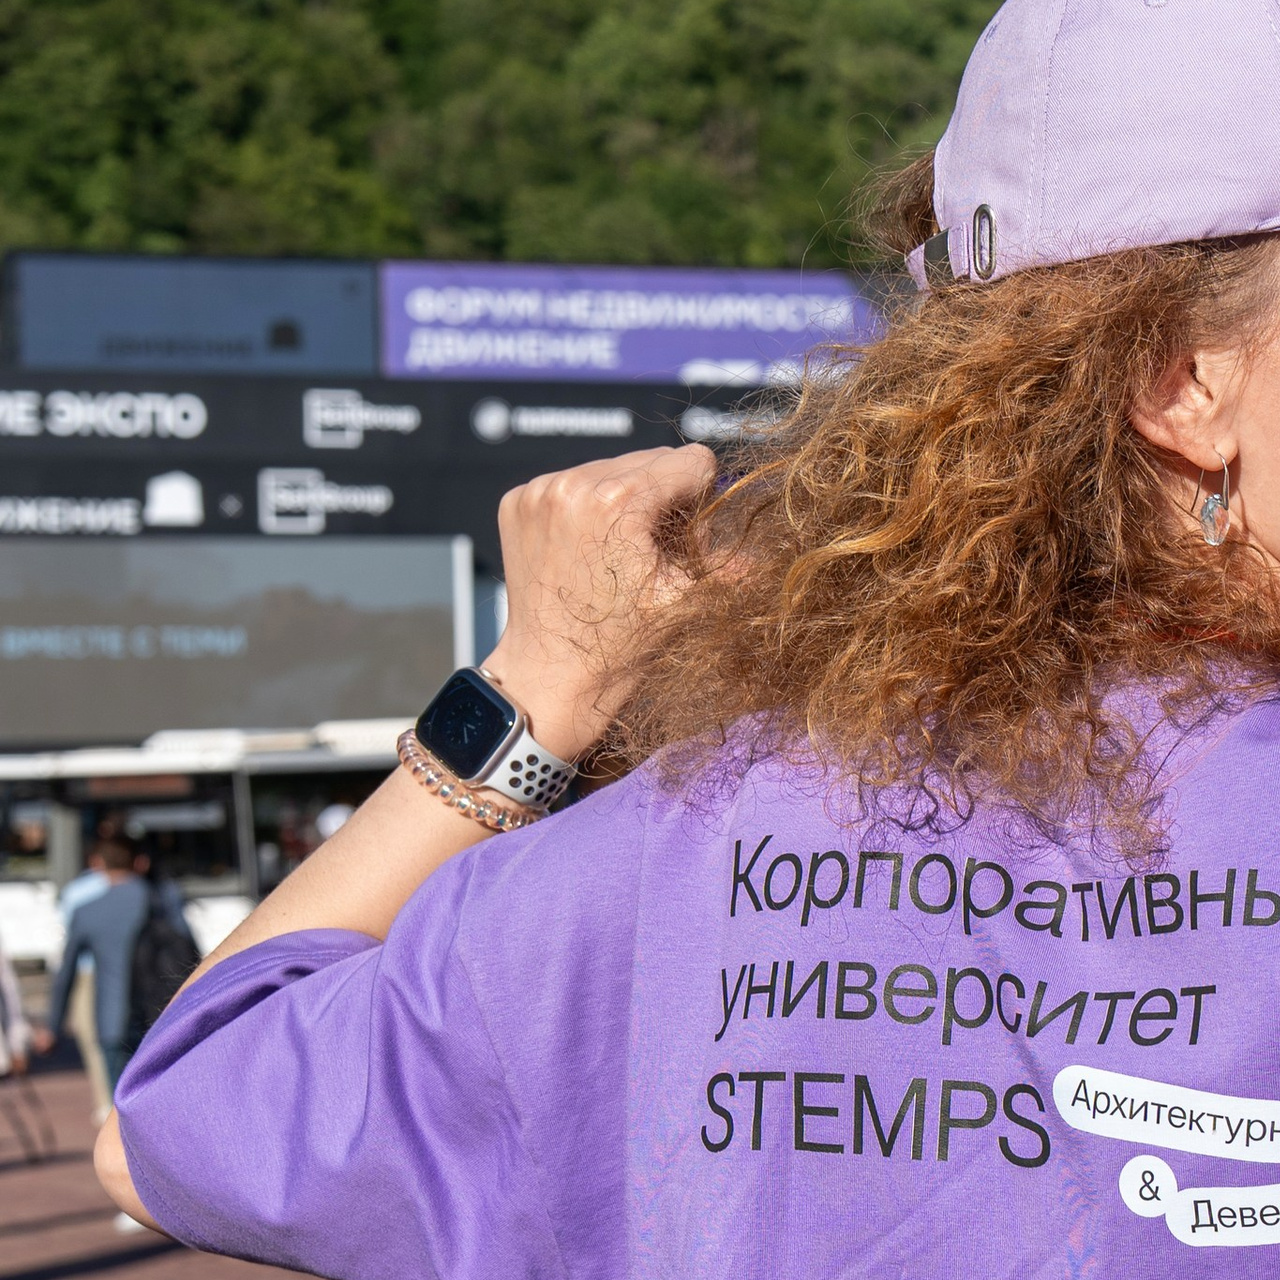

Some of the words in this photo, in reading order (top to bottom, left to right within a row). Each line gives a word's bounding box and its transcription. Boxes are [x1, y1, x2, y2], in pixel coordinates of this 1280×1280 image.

[406, 286, 541, 323] ФОРУМ
[406, 326, 620, 370] ДВИЖЕНИЕ
[45, 390, 207, 439] ЭКСПО
[714, 960, 1217, 1046] университет
[700, 1071, 1052, 1168] STEMPS
[1138, 1169, 1162, 1202] &
